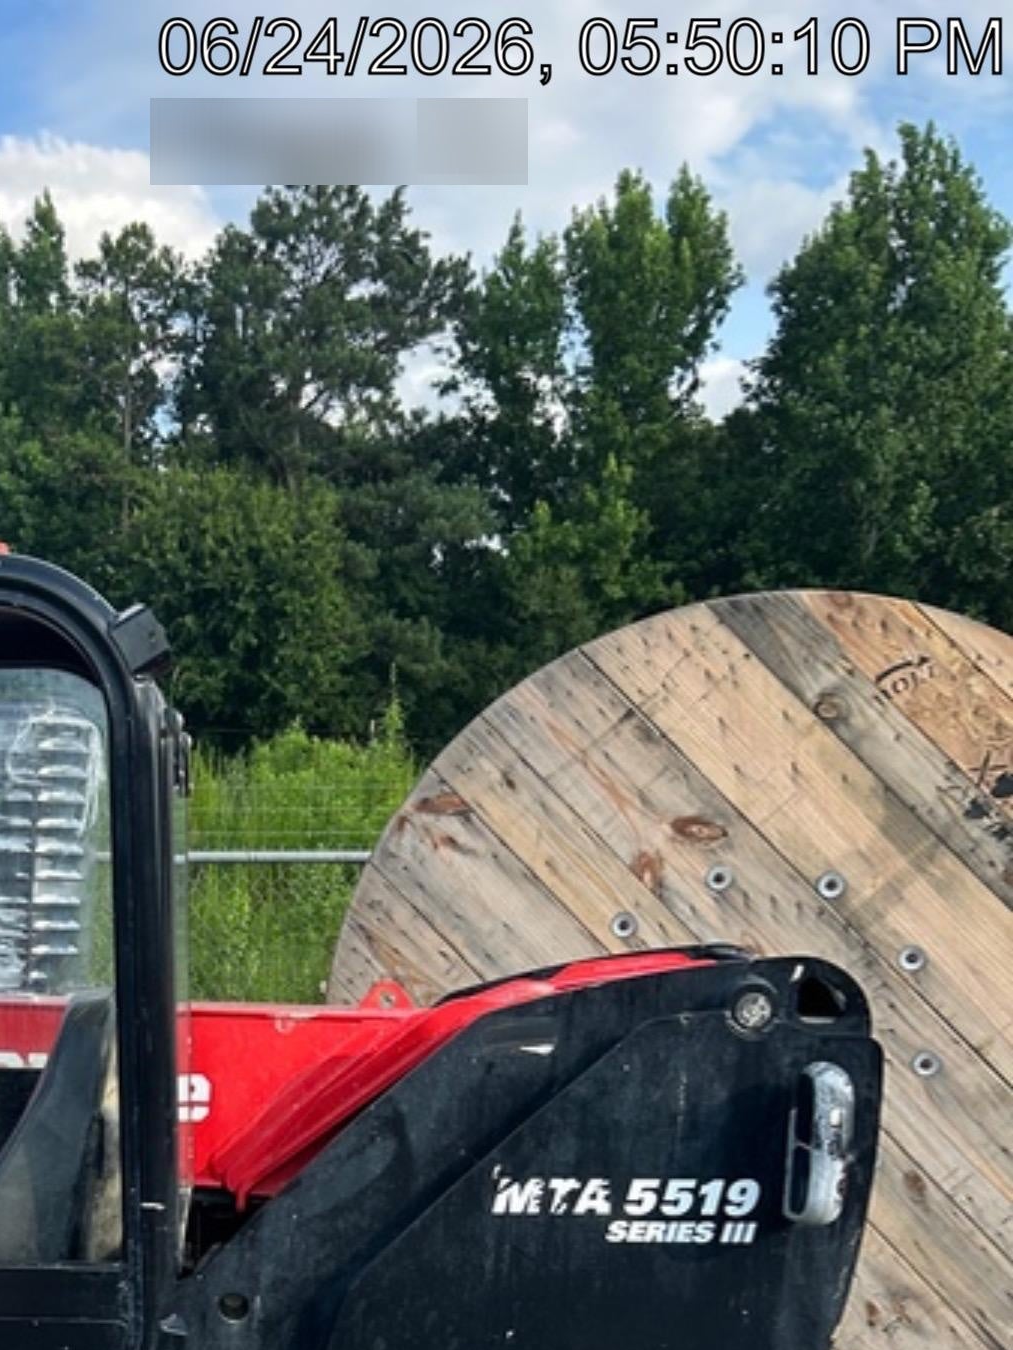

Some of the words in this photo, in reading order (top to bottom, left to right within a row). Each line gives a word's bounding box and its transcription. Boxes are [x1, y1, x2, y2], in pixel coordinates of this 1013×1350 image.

[491, 1178, 612, 1215] MTA
[623, 1178, 760, 1216] 5519
[605, 1220, 715, 1243] SERIES
[720, 1220, 757, 1243] III
